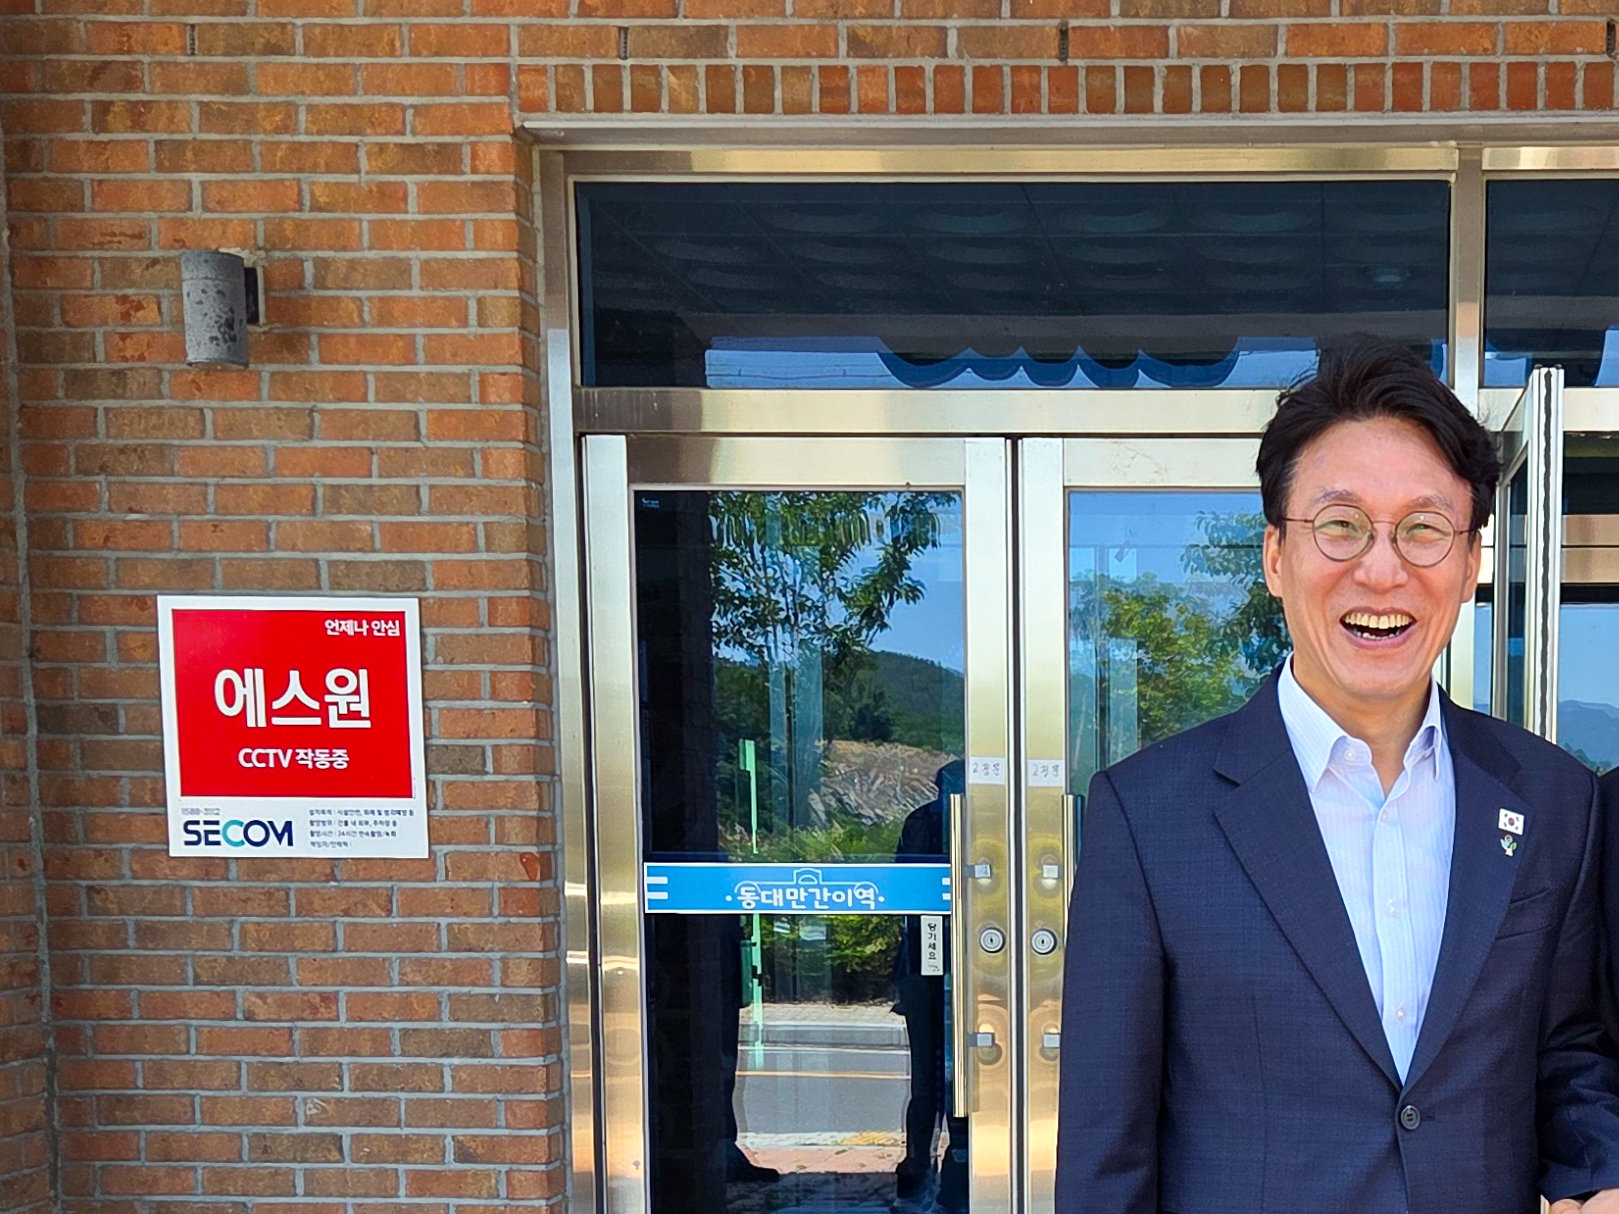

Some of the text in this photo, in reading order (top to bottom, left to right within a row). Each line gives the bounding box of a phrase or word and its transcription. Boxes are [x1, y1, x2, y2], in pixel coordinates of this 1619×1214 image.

[324, 619, 400, 637] 언제나 안심
[213, 668, 371, 729] 에스원
[238, 747, 350, 769] CCTV 작동중
[182, 819, 294, 848] SECOM
[737, 886, 875, 910] 동대만간이역
[927, 923, 937, 960] 당기세요
